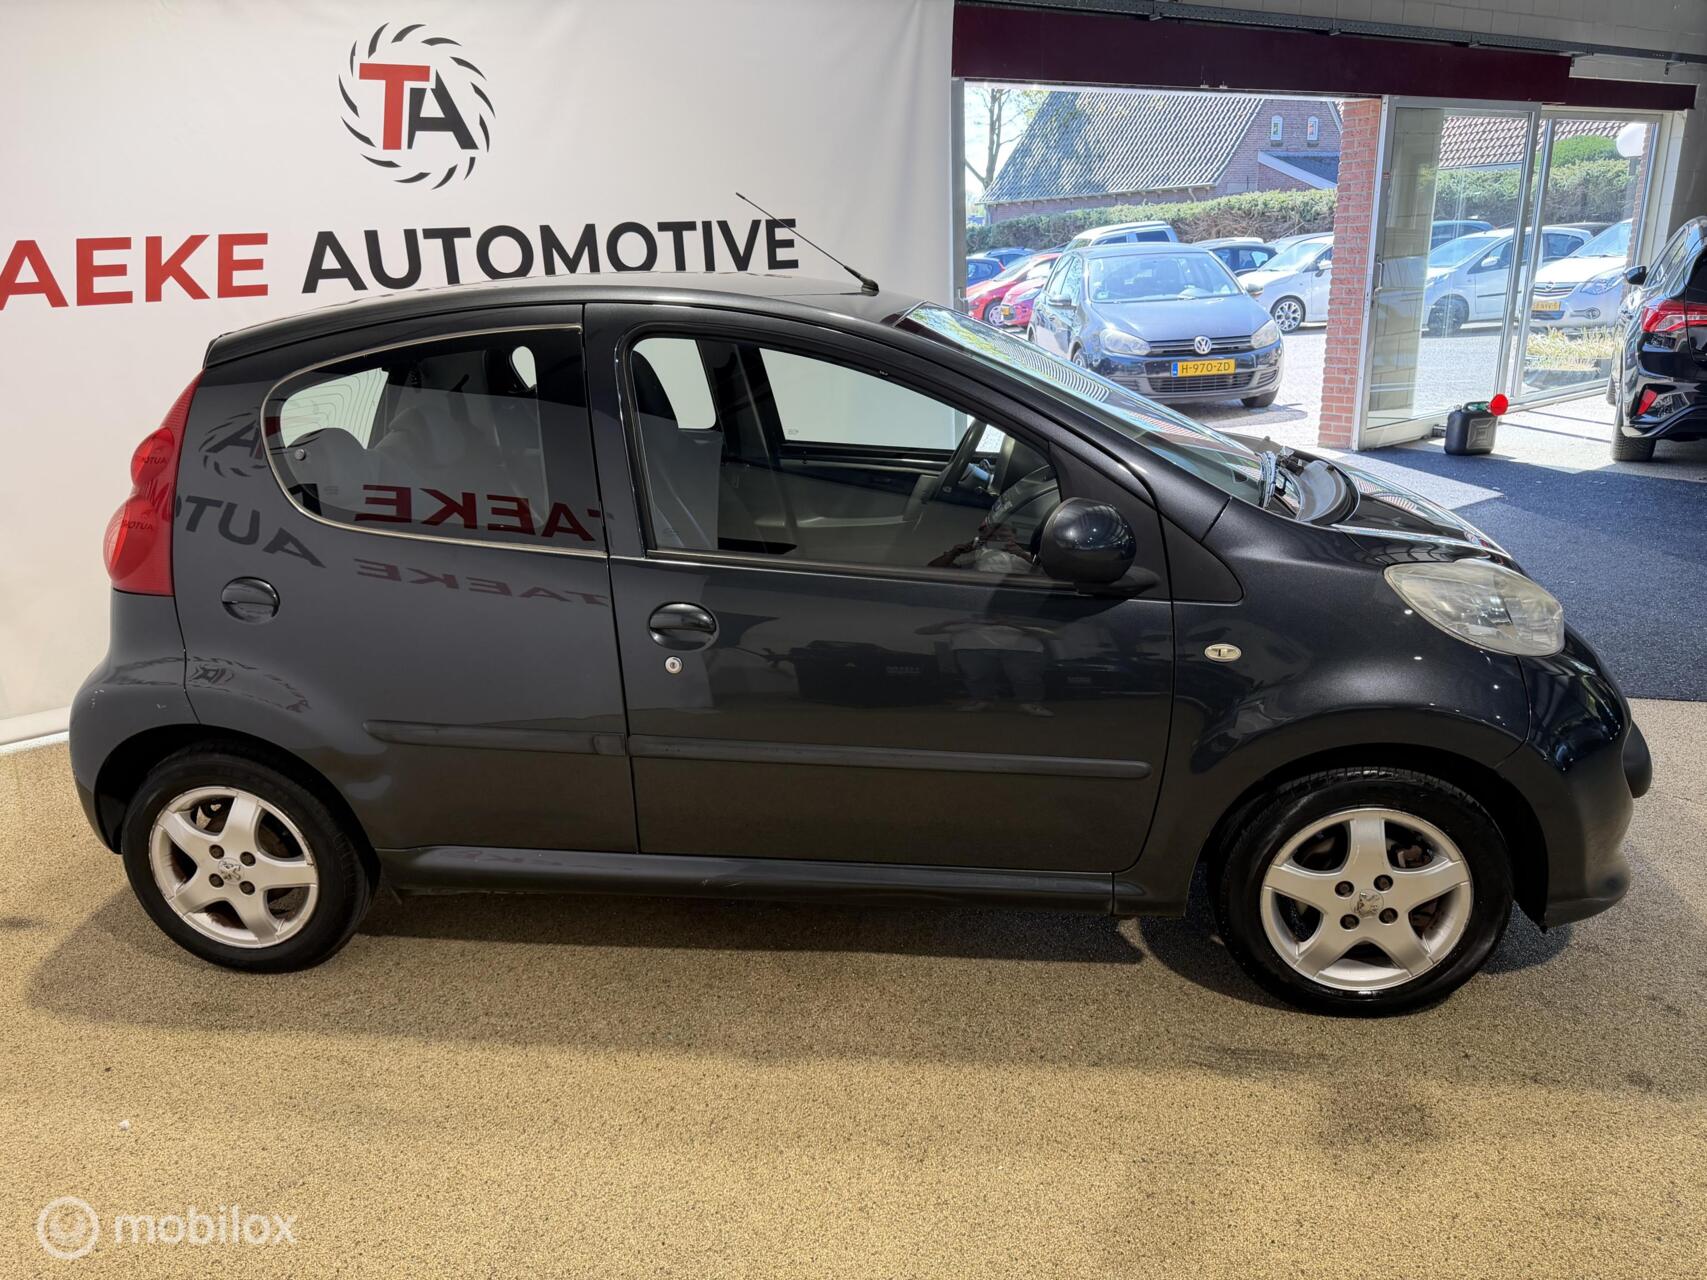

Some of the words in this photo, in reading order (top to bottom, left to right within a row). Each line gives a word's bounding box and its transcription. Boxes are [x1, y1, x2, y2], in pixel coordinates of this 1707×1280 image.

[359, 62, 480, 151] TA
[301, 218, 800, 294] AUTOMOTIVE
[1181, 362, 1231, 375] H-970-ZD
